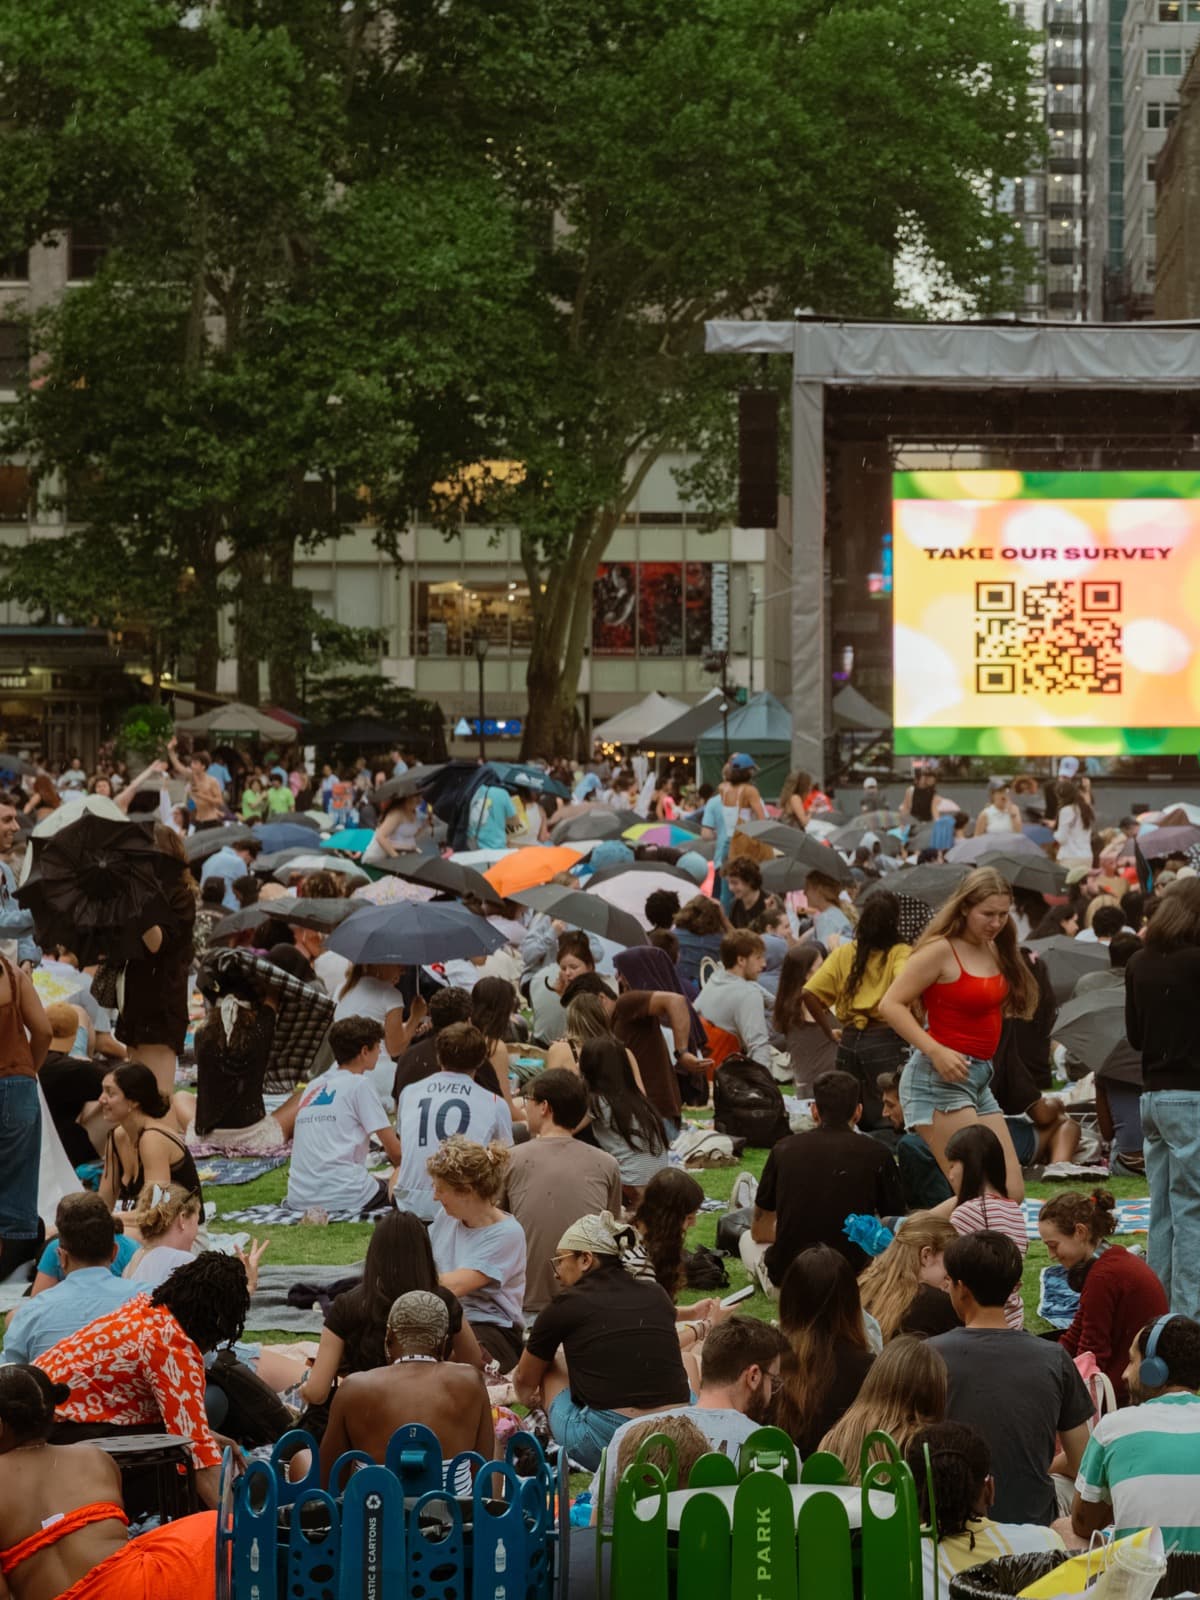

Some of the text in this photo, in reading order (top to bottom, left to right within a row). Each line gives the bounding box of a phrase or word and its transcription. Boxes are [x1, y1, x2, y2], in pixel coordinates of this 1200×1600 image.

[924, 547, 1173, 560] TAKE OUR SURVEY
[426, 1081, 473, 1096] OWEN
[417, 1097, 472, 1148] 10
[368, 1516, 377, 1564] CARTONS
[756, 1506, 772, 1581] PARK
[368, 1564, 377, 1573] &
